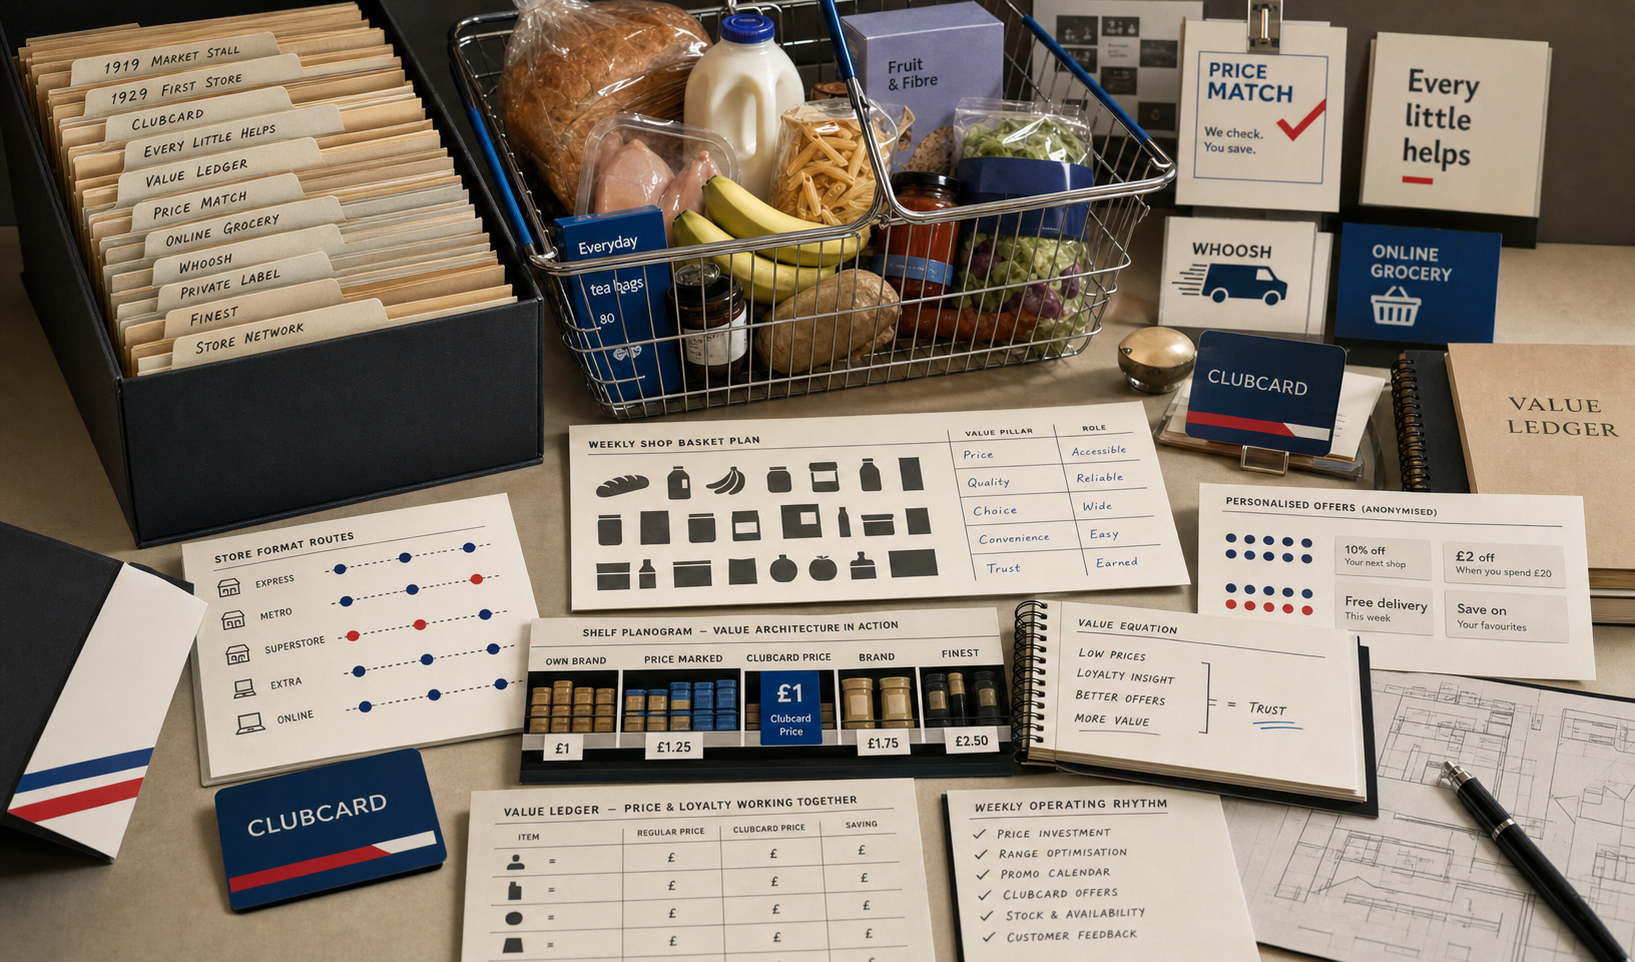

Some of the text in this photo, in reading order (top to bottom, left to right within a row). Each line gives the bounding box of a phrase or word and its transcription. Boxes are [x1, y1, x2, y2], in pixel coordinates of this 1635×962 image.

[105, 46, 240, 74] 1919 MARKET STALL
[888, 58, 923, 74] Fruit
[1209, 62, 1267, 79] PRICE
[112, 74, 242, 105] 1929 FIRST STORE
[888, 75, 938, 91] & Fibre
[1408, 68, 1480, 103] Every
[1208, 82, 1293, 103] MATCH
[132, 107, 204, 131] CLUBCARD
[1406, 103, 1471, 131] little
[1205, 126, 1263, 139] We check.
[144, 124, 276, 158] EVERY LITTLE HELPS
[1204, 141, 1256, 154] You save.
[1403, 137, 1470, 172] helps
[146, 159, 247, 188] VALUE LEDGER
[153, 191, 247, 220] PRICE MATCH
[166, 213, 279, 247] ONLINE GROCERY
[579, 235, 638, 255] Everyday
[1193, 242, 1272, 259] WHOOSH
[1372, 244, 1439, 262] ONLINE
[180, 253, 232, 274] WHOOSH
[1371, 264, 1452, 282] GROCERY
[180, 269, 280, 299] PRIVATE LABEL
[590, 284, 611, 296] tea
[190, 306, 238, 327] FINEST
[600, 313, 615, 324] 80
[196, 323, 304, 354] STORE NETWORK
[1208, 369, 1307, 395] CLUBCARD
[1509, 397, 1601, 413] VALUE
[1508, 420, 1619, 437] LEDGER
[641, 440, 673, 448] SHOP
[678, 438, 724, 447] BASKET
[730, 436, 760, 444] PLAN
[964, 450, 993, 459] Price
[1072, 445, 1126, 456] Accessible
[967, 478, 1010, 488] Quality
[1077, 472, 1123, 483] Reliable
[973, 506, 1017, 516] Choice
[1083, 501, 1112, 511] Wide
[1226, 497, 1437, 517] PERSONALISED OFFERS (ANONYMISED)
[979, 534, 1049, 545] Convenience
[1090, 529, 1119, 541] Easy
[215, 532, 354, 563] STORE FORMAT ROUTES
[1345, 545, 1385, 555] 10% off
[1096, 556, 1138, 568] Earned
[1456, 551, 1495, 562] £2 off
[986, 563, 1020, 574] Trust
[1345, 558, 1363, 566] Your
[1386, 560, 1406, 570] shop
[1455, 566, 1552, 578] When you spend £20
[256, 574, 294, 588] EXPRESS
[1345, 596, 1428, 614] Free delivery
[1457, 603, 1506, 616] Save on
[260, 608, 292, 620] METRO
[1345, 611, 1391, 622] This week
[583, 621, 898, 637] SHELF PLANOGRAM VALUE ARCHITECTURE IN ACTION
[1079, 619, 1177, 634] VALUE EQUATION
[1457, 620, 1527, 632] Your favourites
[265, 636, 325, 654] SUPERSTORE
[644, 654, 723, 664] PRICE MARKED
[746, 653, 831, 662] CLUBCARD PRICE
[859, 653, 895, 662] BRAND
[942, 649, 979, 658] FINEST
[1079, 648, 1146, 661] LOW PRICES
[546, 657, 606, 666] OWN BRAND
[1077, 668, 1175, 685] LOYALTY INSIGHT
[271, 677, 302, 690] EXTRA
[777, 684, 802, 702] £1
[1075, 690, 1165, 706] BETTER OFFERS
[1249, 702, 1287, 715] TRUST
[277, 710, 314, 724] ONLINE
[770, 714, 811, 723] Clubcard
[1074, 713, 1149, 727] MORE VALUE
[780, 727, 803, 736] Price
[657, 741, 691, 753] £1.25
[868, 738, 899, 749] £1.75
[955, 735, 988, 747] £2.50
[555, 743, 569, 754] £1
[504, 796, 857, 817] VALUE LEDGER PRICE & LOYALTY WORKING TOGETHER
[975, 799, 1167, 812] WEEKLY OPERATING RHYTHM
[248, 794, 387, 836] CLUBCARD
[846, 820, 878, 829] SAVING
[637, 828, 677, 837] REGULAR
[997, 828, 1111, 839] PRICE INVESTMENT
[999, 848, 1127, 859] RANGE OPTIMISATION
[1001, 868, 1110, 879] PROMO CALENDAR
[1003, 888, 1118, 900] CLUBCARD OFFERS
[1006, 908, 1145, 921] STOCK & AVAILABILITY
[1007, 930, 1137, 943] CUSTOMER FEEDBACK
